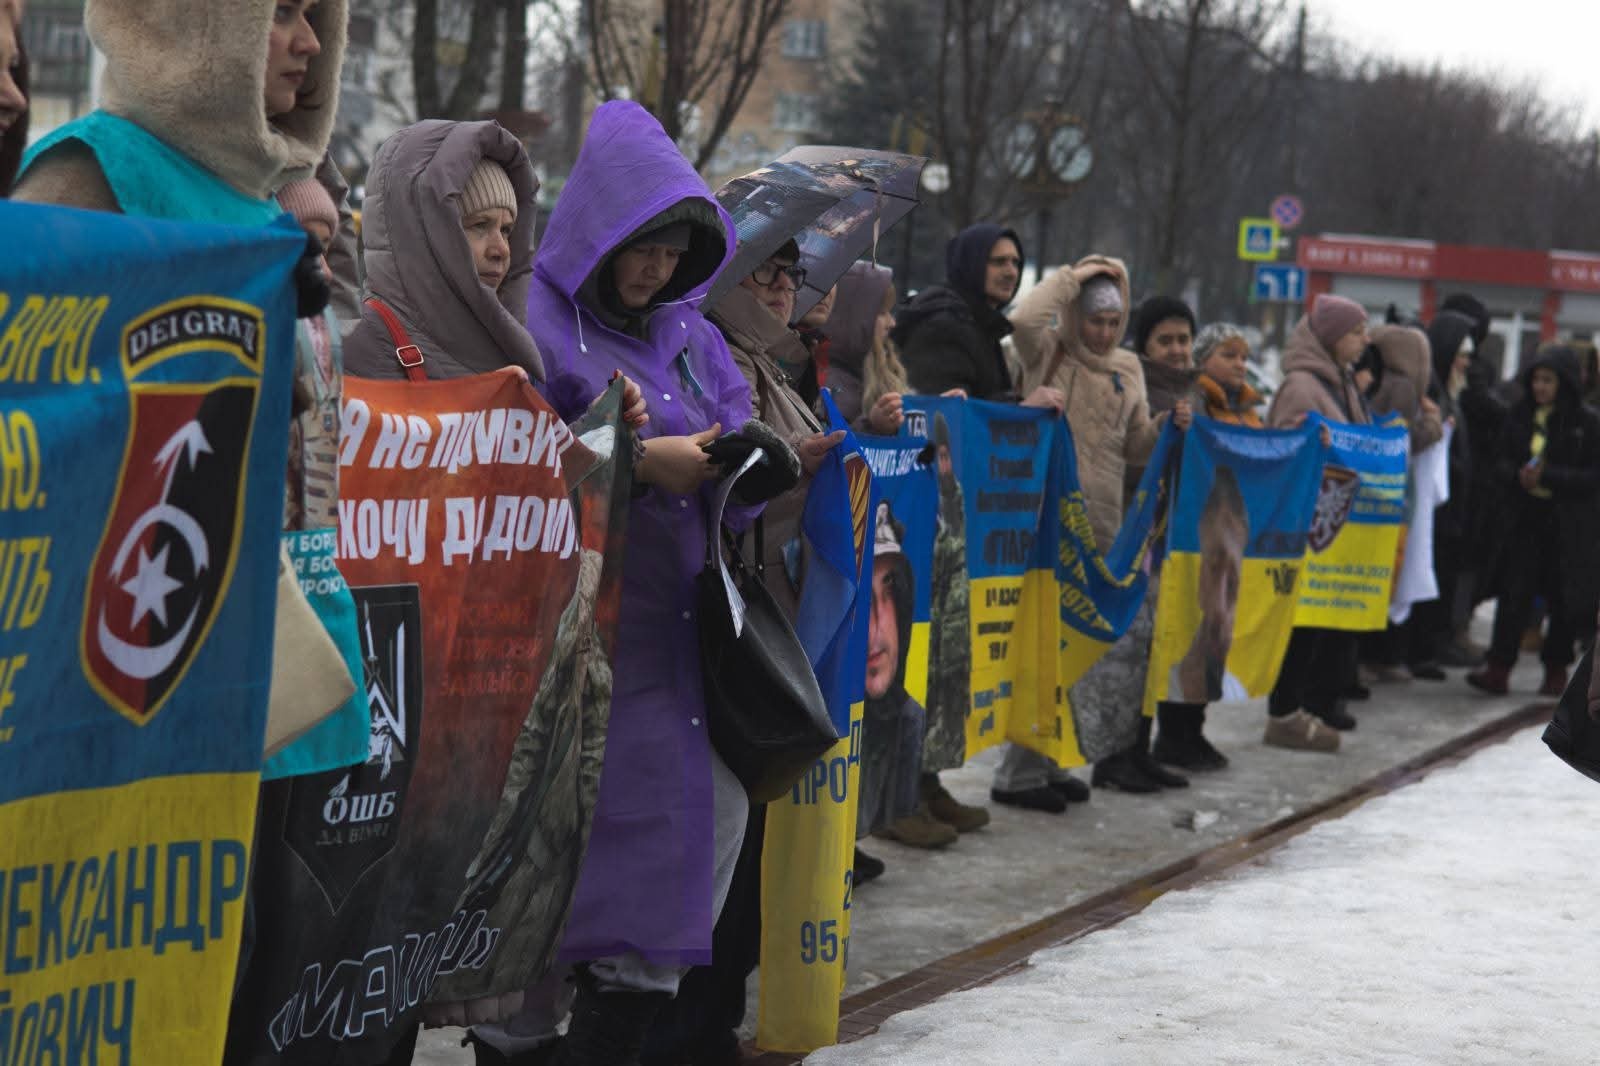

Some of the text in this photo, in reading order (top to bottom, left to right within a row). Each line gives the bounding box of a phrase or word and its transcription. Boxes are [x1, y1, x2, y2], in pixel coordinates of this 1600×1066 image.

[129, 315, 178, 358] DEI
[338, 399, 371, 467] Я
[367, 412, 432, 470] не
[310, 555, 337, 574] БО
[0, 839, 247, 976] ЕКСАНДР
[800, 919, 838, 964] 95
